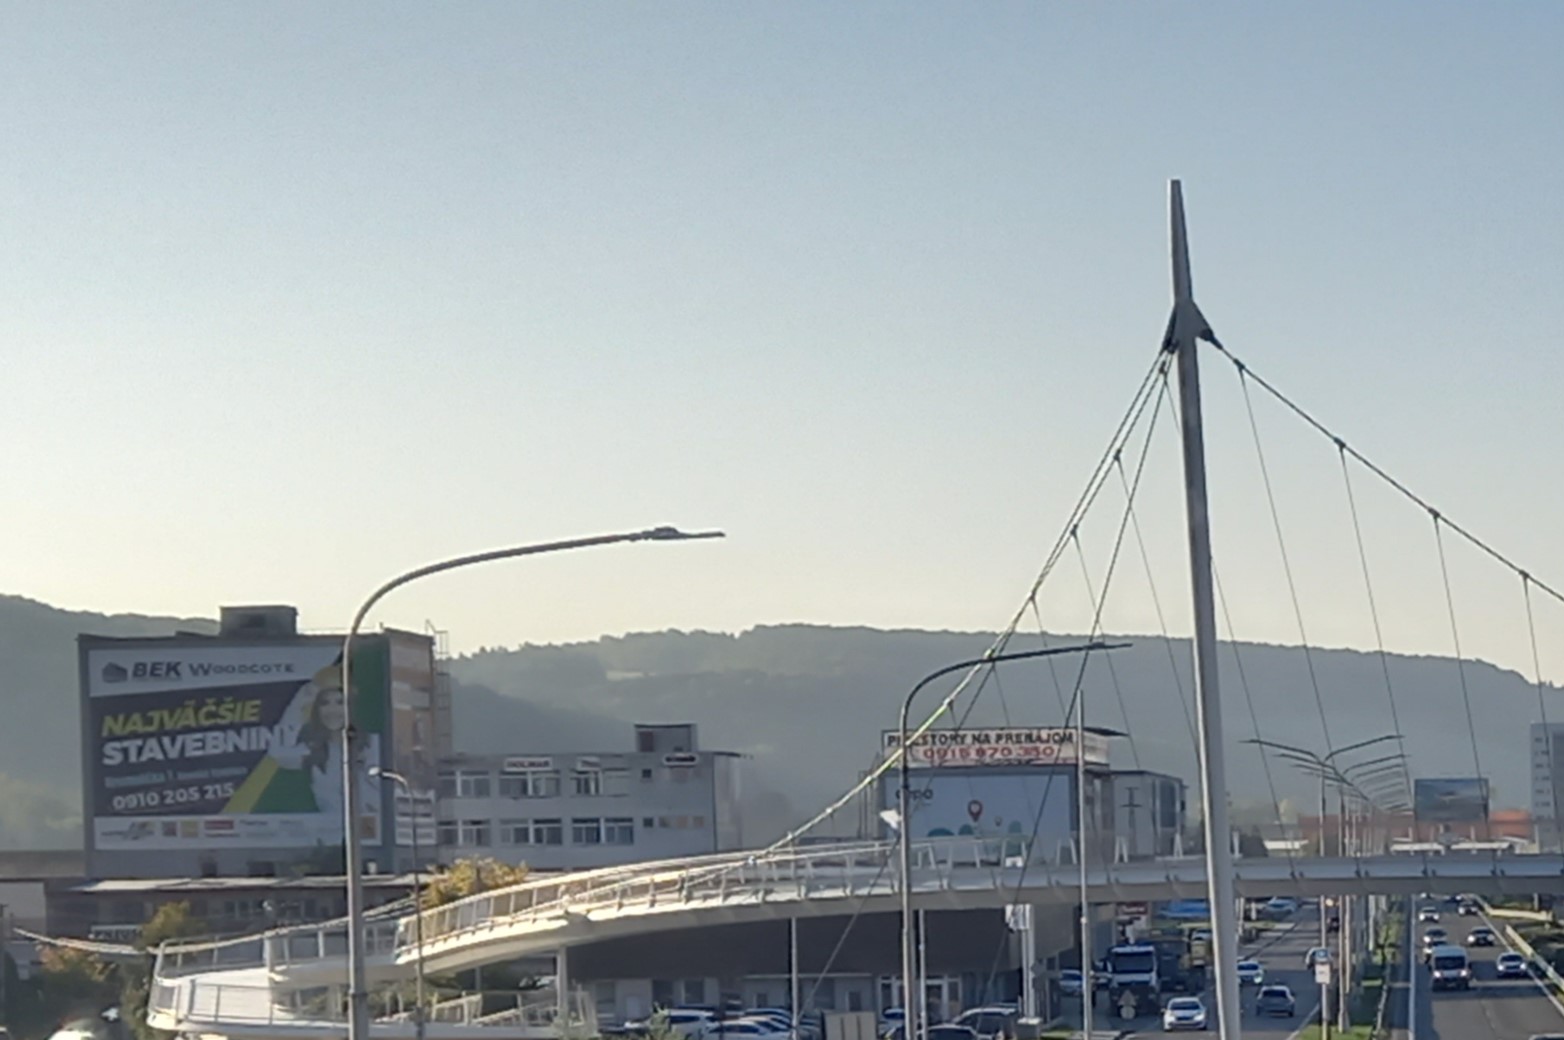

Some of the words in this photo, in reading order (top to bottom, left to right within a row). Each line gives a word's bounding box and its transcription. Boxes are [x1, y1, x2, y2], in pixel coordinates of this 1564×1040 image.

[132, 661, 182, 678] BEK
[102, 697, 262, 737] NAJVÄČŠIE
[102, 725, 301, 765] STAVEBNINY
[972, 731, 992, 745] NA
[112, 790, 160, 810] 0910
[162, 786, 201, 805] 205
[204, 782, 235, 800] 215
